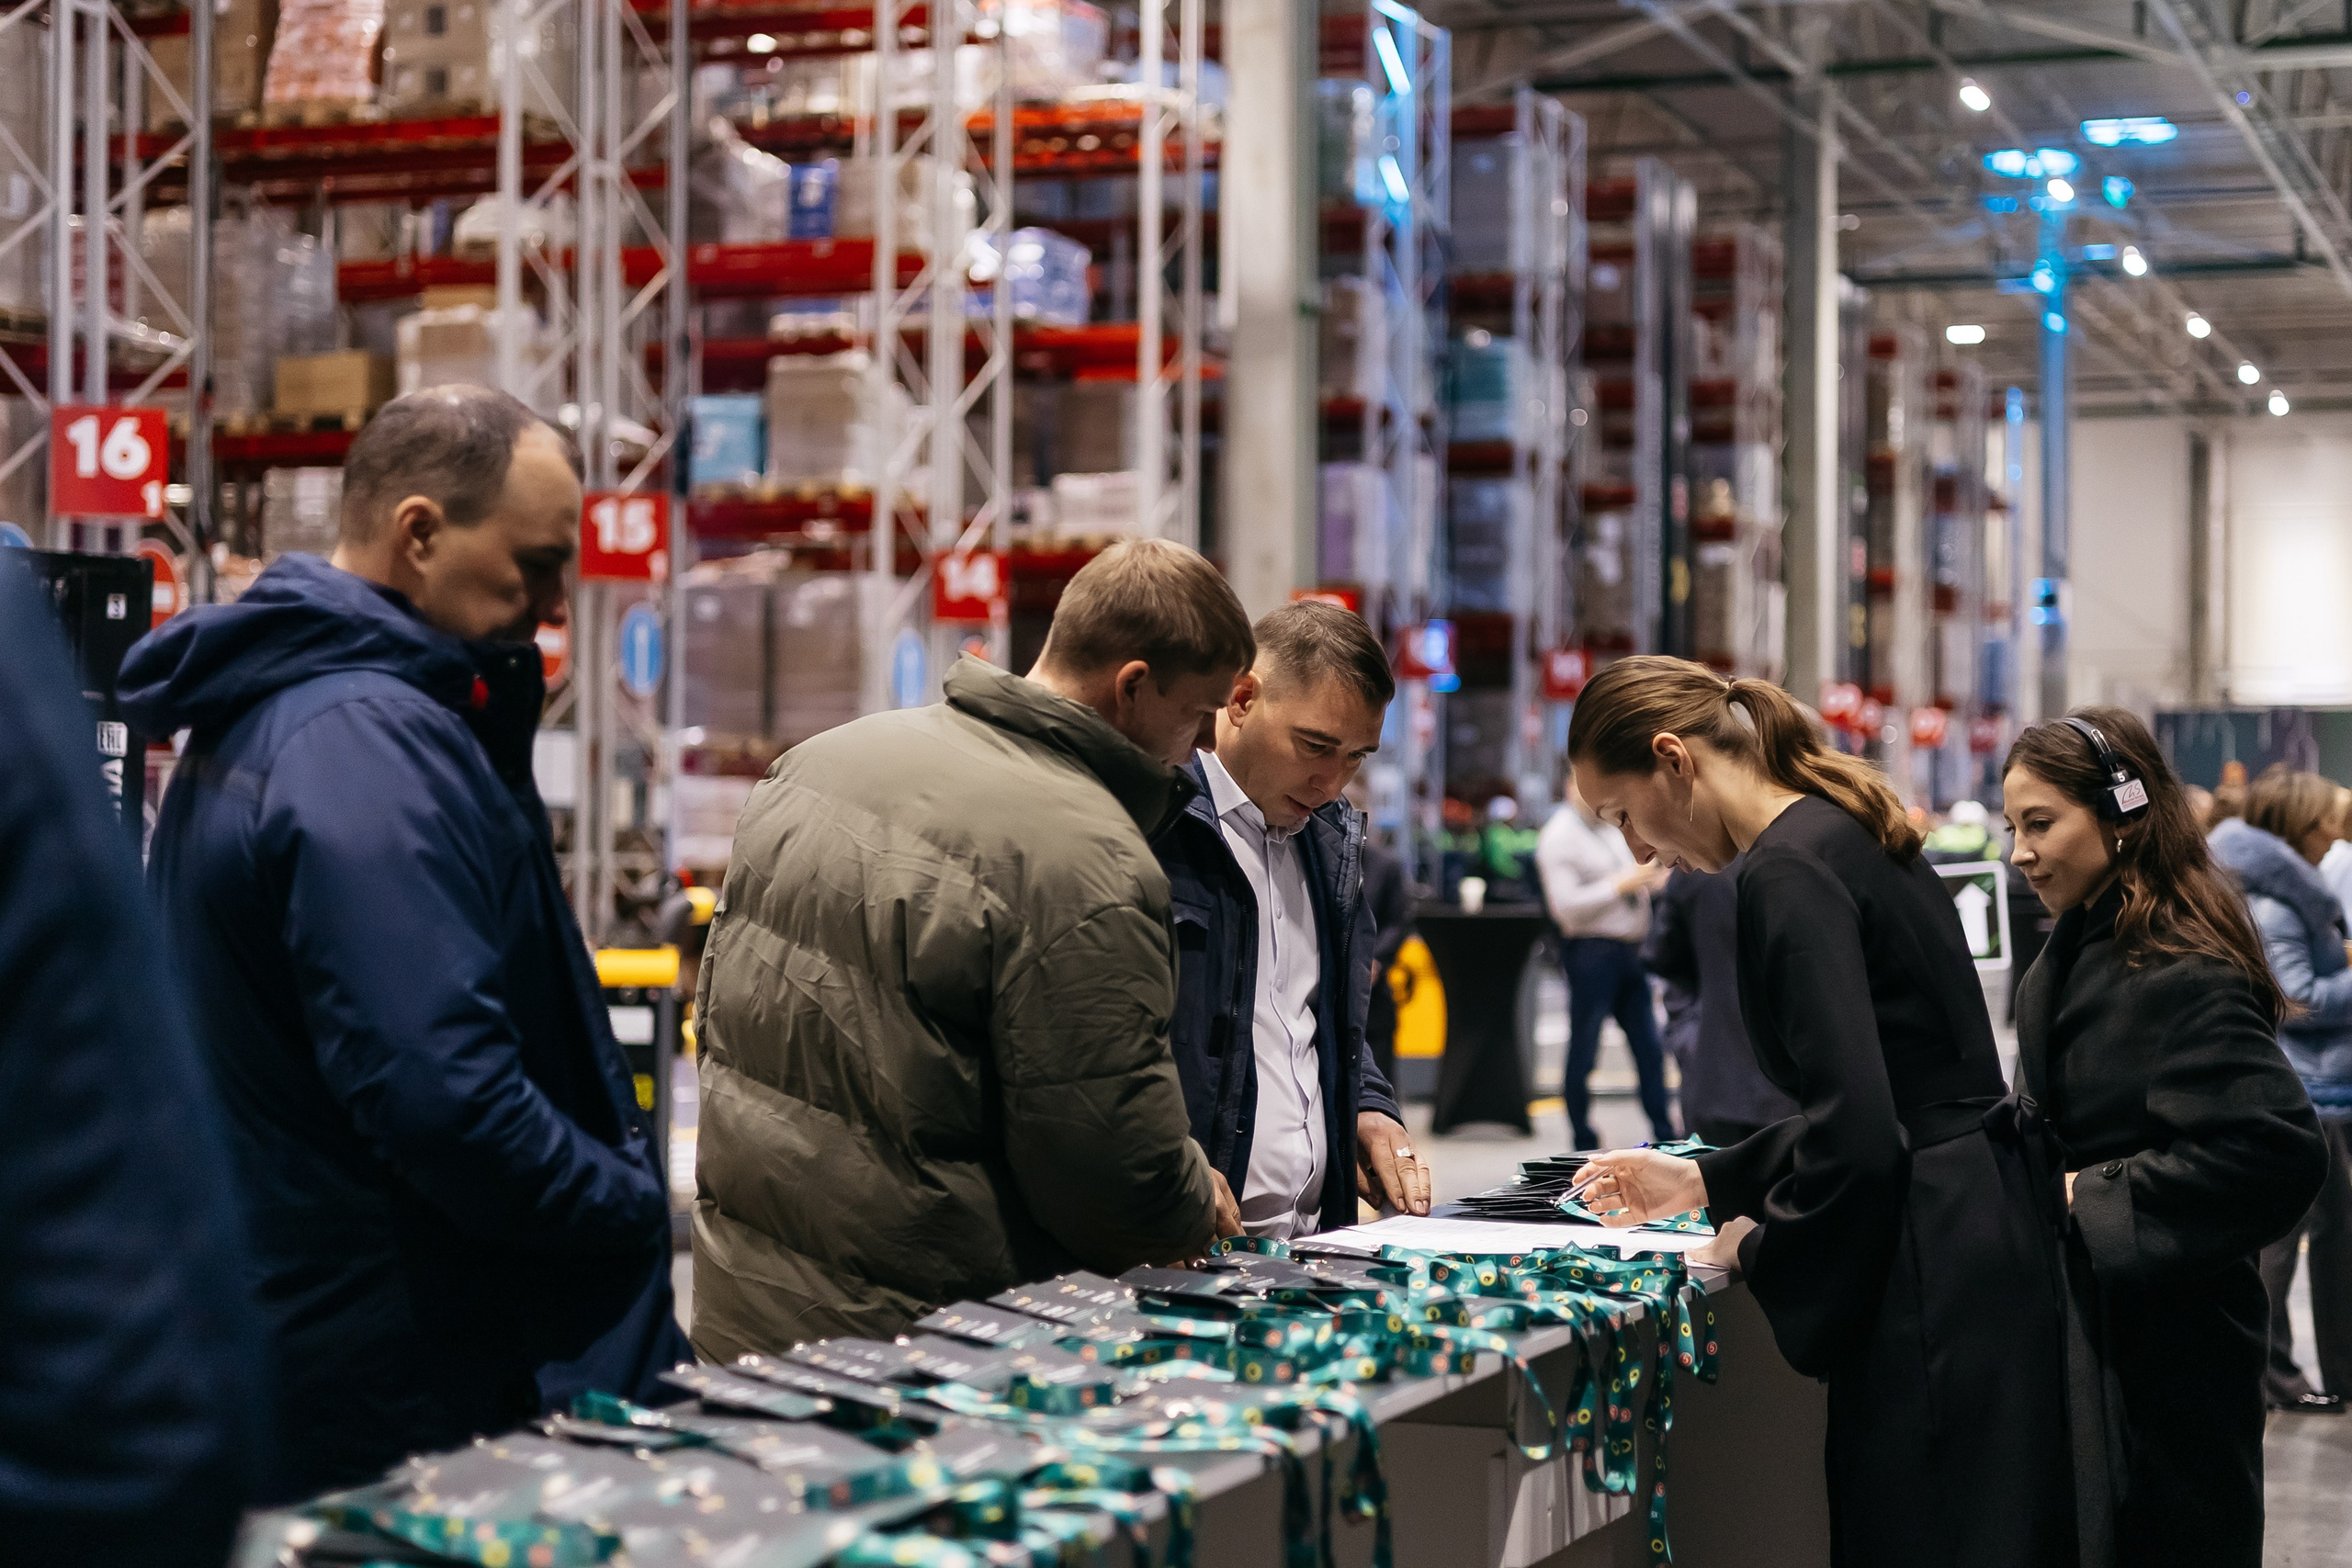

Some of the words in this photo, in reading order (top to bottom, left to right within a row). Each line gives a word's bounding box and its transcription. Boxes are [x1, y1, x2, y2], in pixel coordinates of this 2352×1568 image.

[65, 415, 152, 479] 16
[141, 479, 162, 516] 1
[590, 497, 657, 554] 15
[940, 554, 998, 601] 14
[2117, 773, 2126, 783] 5
